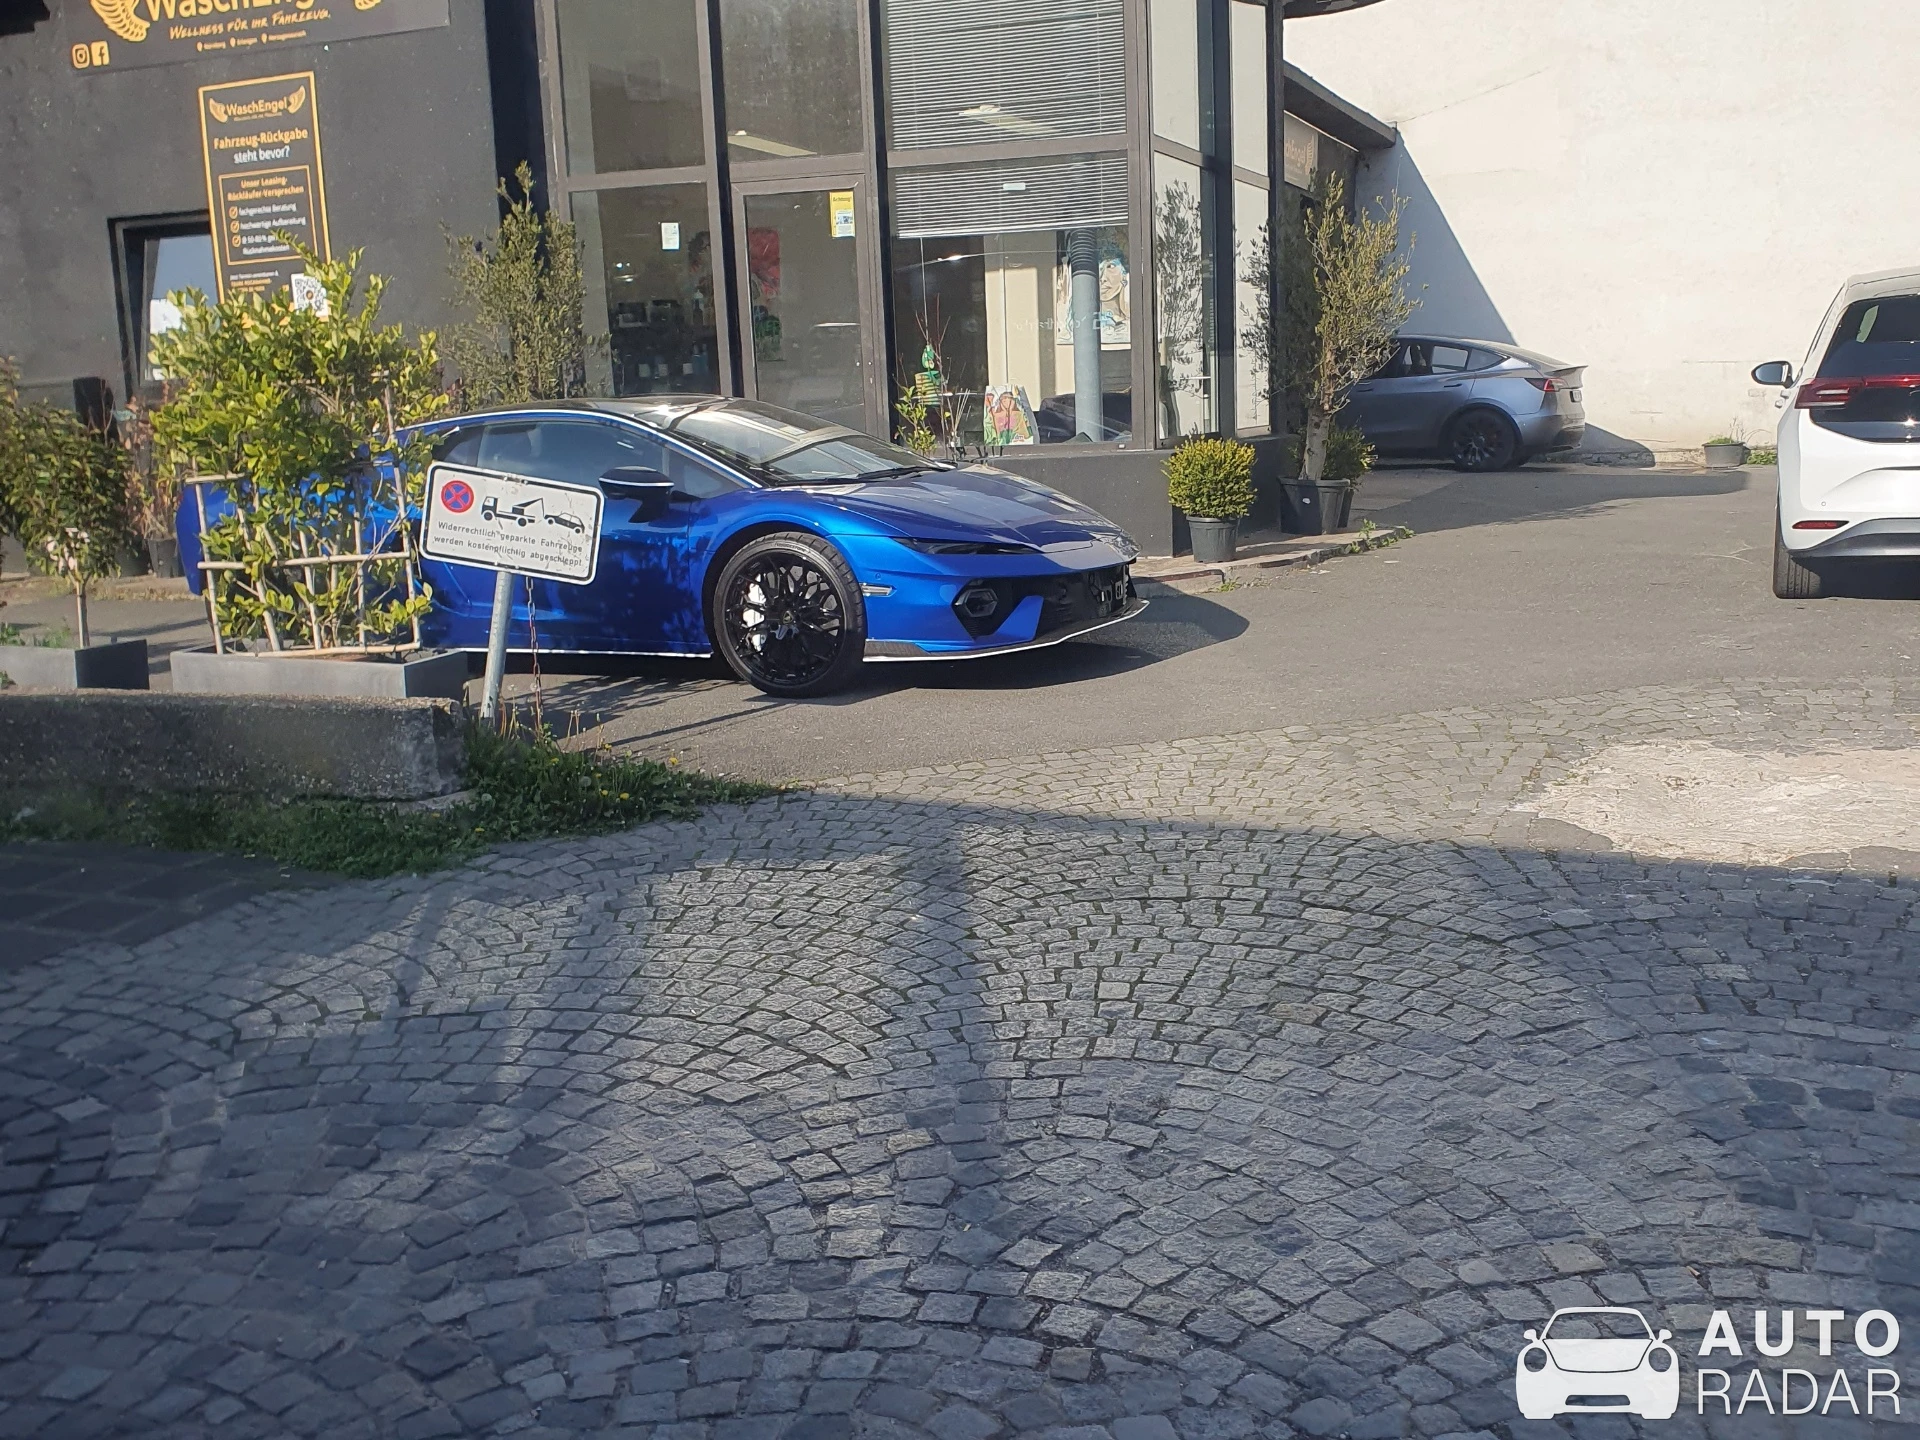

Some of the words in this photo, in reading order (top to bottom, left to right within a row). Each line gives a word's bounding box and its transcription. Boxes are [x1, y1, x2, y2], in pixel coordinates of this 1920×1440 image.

[226, 96, 288, 116] WaschEngel
[213, 127, 309, 149] Fahrzeug-Rückgabe
[233, 149, 258, 164] steht
[259, 145, 290, 161] bevor?
[438, 521, 496, 538] Widerrechtlich
[500, 533, 536, 546] geparkte
[540, 538, 583, 554] Fahrzeuge
[433, 536, 464, 547] werden
[467, 541, 526, 558] kostenpflichtig
[529, 551, 583, 566] abgeschleppt
